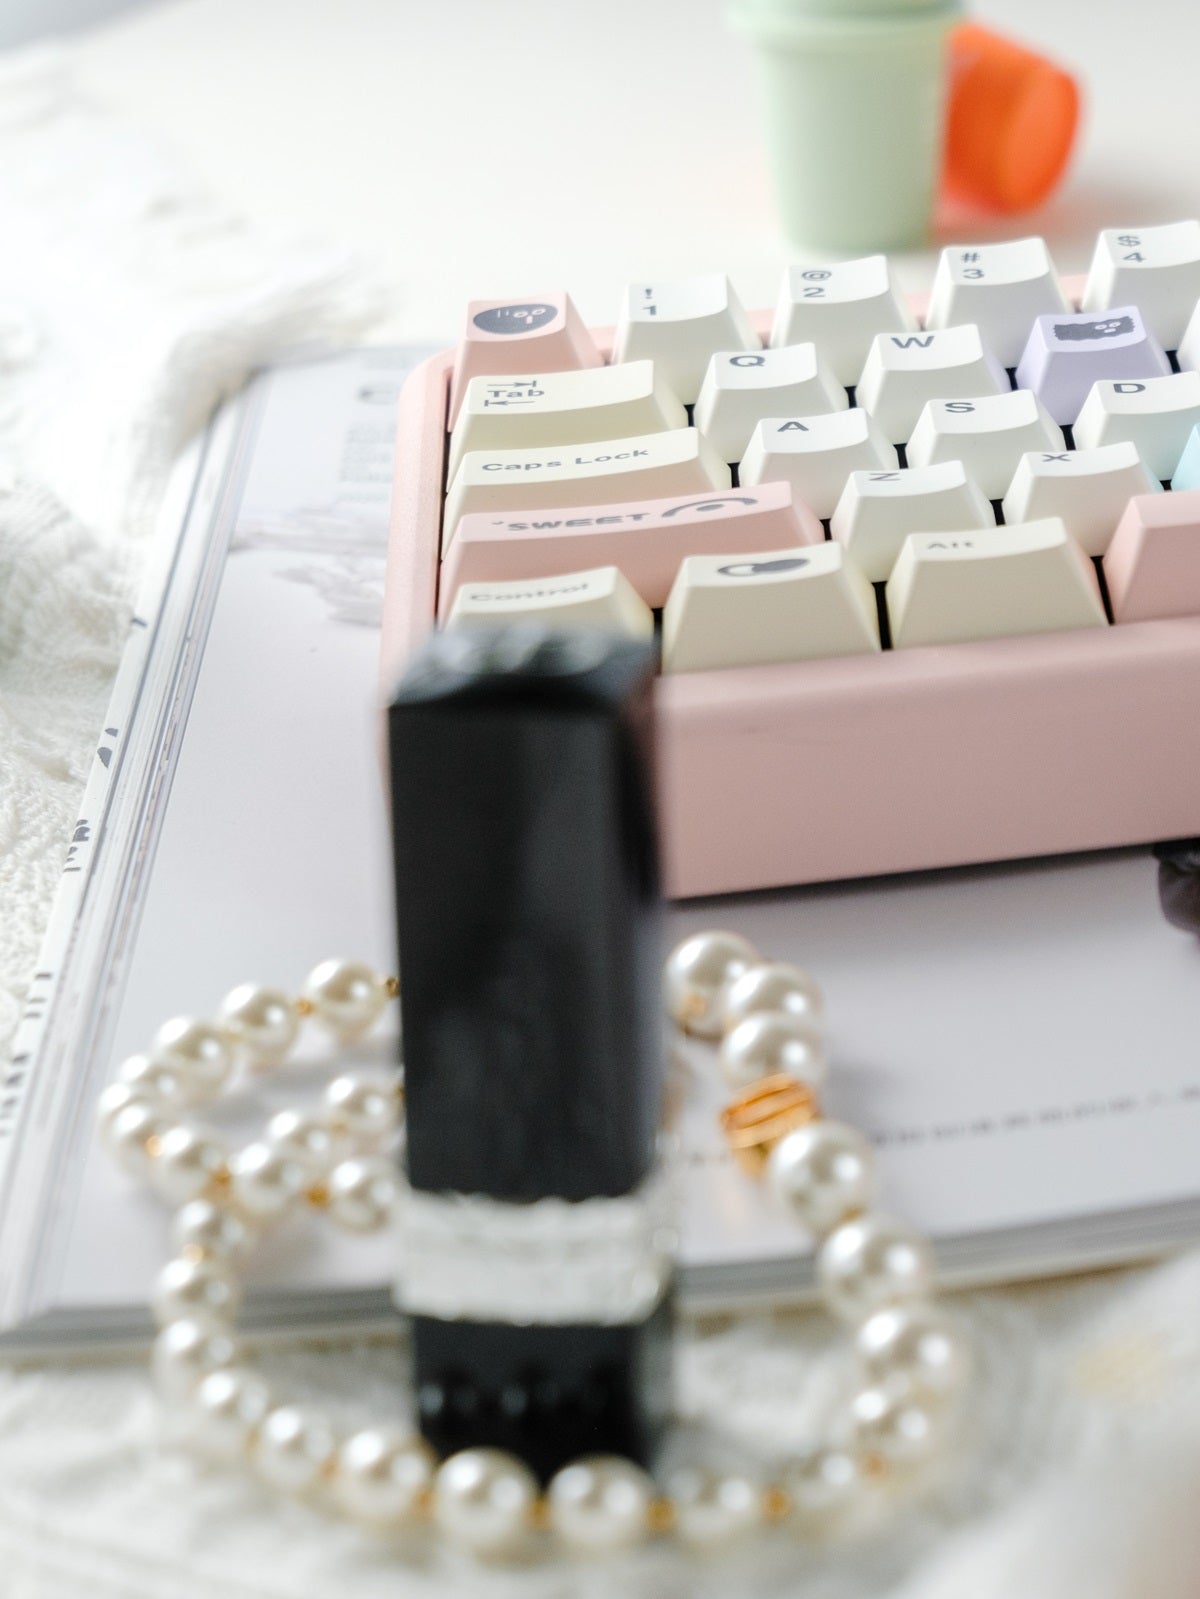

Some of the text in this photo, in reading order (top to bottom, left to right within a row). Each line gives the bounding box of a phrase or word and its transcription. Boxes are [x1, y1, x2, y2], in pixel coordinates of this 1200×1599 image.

[1117, 234, 1142, 248] $
[961, 251, 981, 263] #
[1122, 251, 1146, 264] 4
[800, 269, 832, 282] @
[963, 268, 985, 280] 3
[643, 287, 654, 301] !
[803, 286, 826, 299] 2
[643, 304, 657, 317] 1
[890, 335, 936, 350] W
[727, 354, 766, 370] Q
[488, 388, 547, 399] Tab
[1112, 382, 1147, 395] D
[943, 400, 976, 414] S
[776, 420, 811, 434] A
[481, 448, 649, 473] Caps Lock
[1041, 452, 1073, 463] X
[868, 471, 902, 483] Z
[926, 540, 976, 550] Alt
[469, 582, 589, 602] Control
